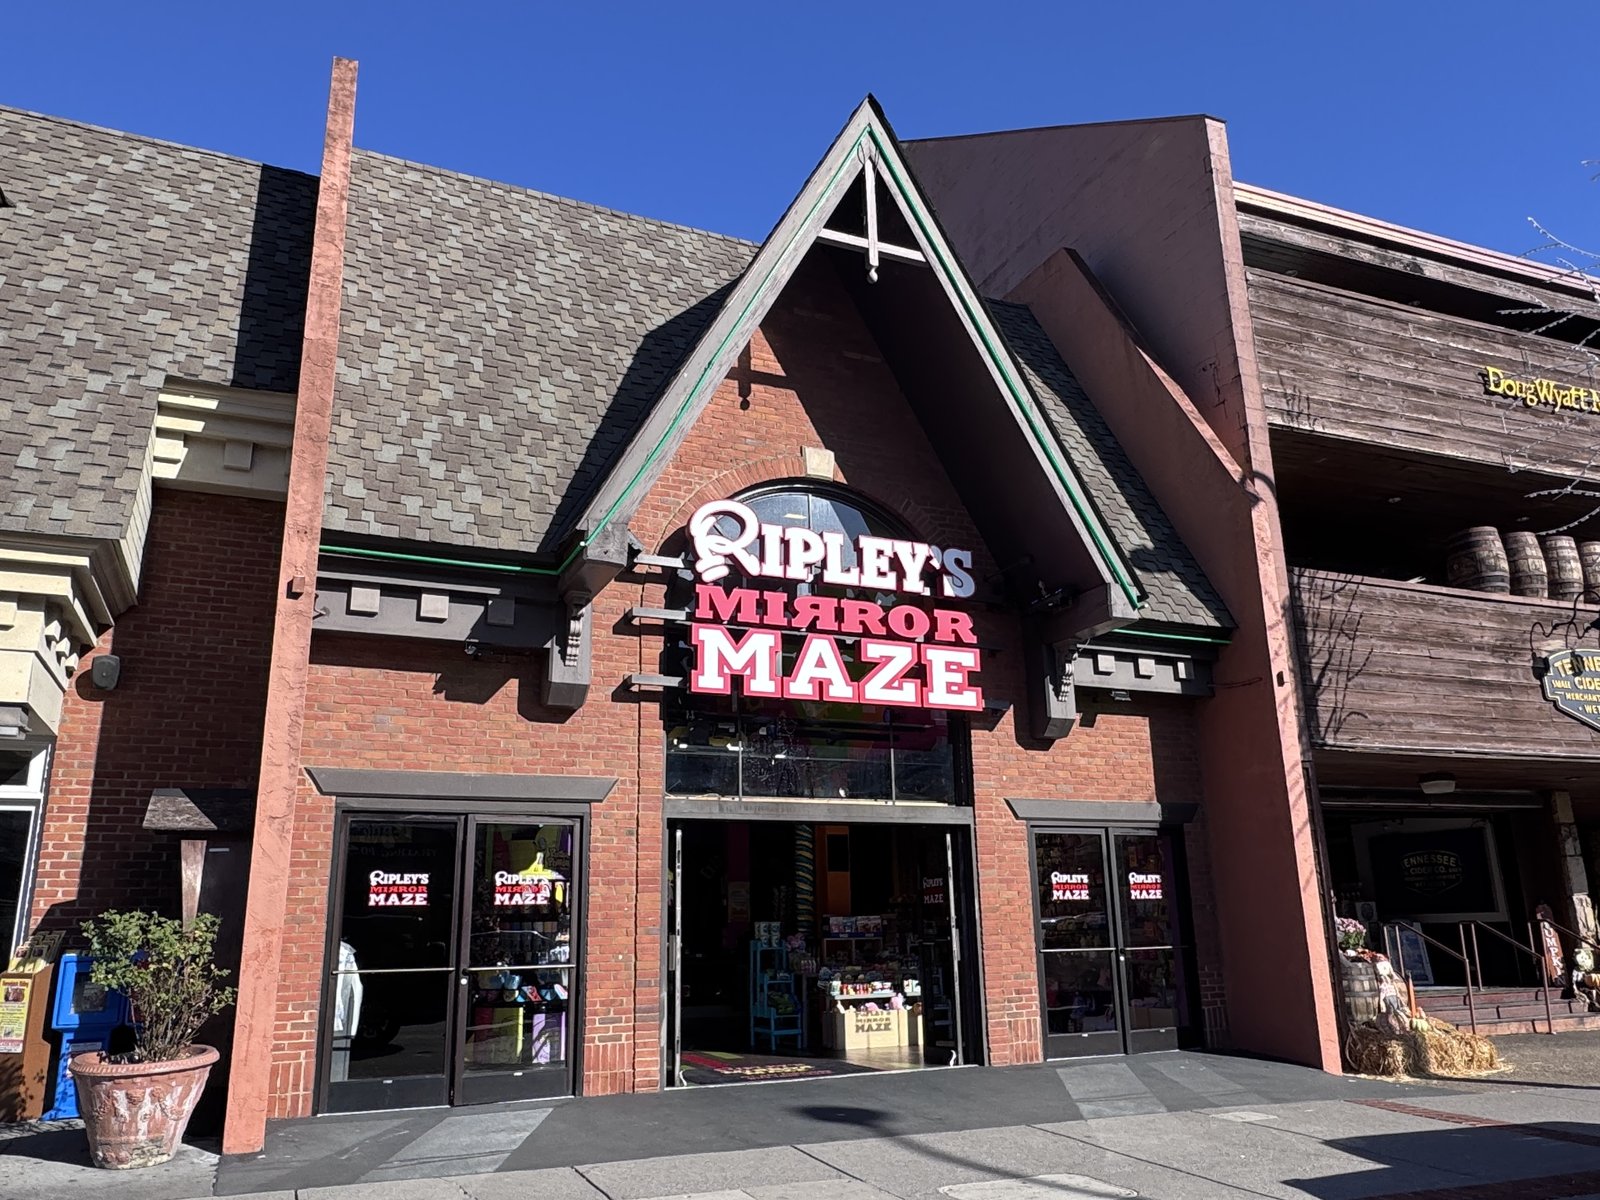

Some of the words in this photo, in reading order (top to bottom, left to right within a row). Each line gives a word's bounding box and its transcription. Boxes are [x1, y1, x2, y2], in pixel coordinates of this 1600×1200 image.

[689, 499, 977, 598] RIPLEY'S
[691, 622, 984, 711] MAZE
[369, 870, 429, 886] RIPLEY'S
[494, 871, 549, 886] RIPLEY'S
[1051, 871, 1089, 884] RIPLEY'S
[1128, 872, 1161, 884] RIPLEY'S
[368, 893, 428, 906] MAZE
[494, 893, 548, 905] MAZE
[924, 893, 944, 904] MAZE
[1052, 889, 1089, 900] MAZE
[1130, 889, 1162, 900] MAZE
